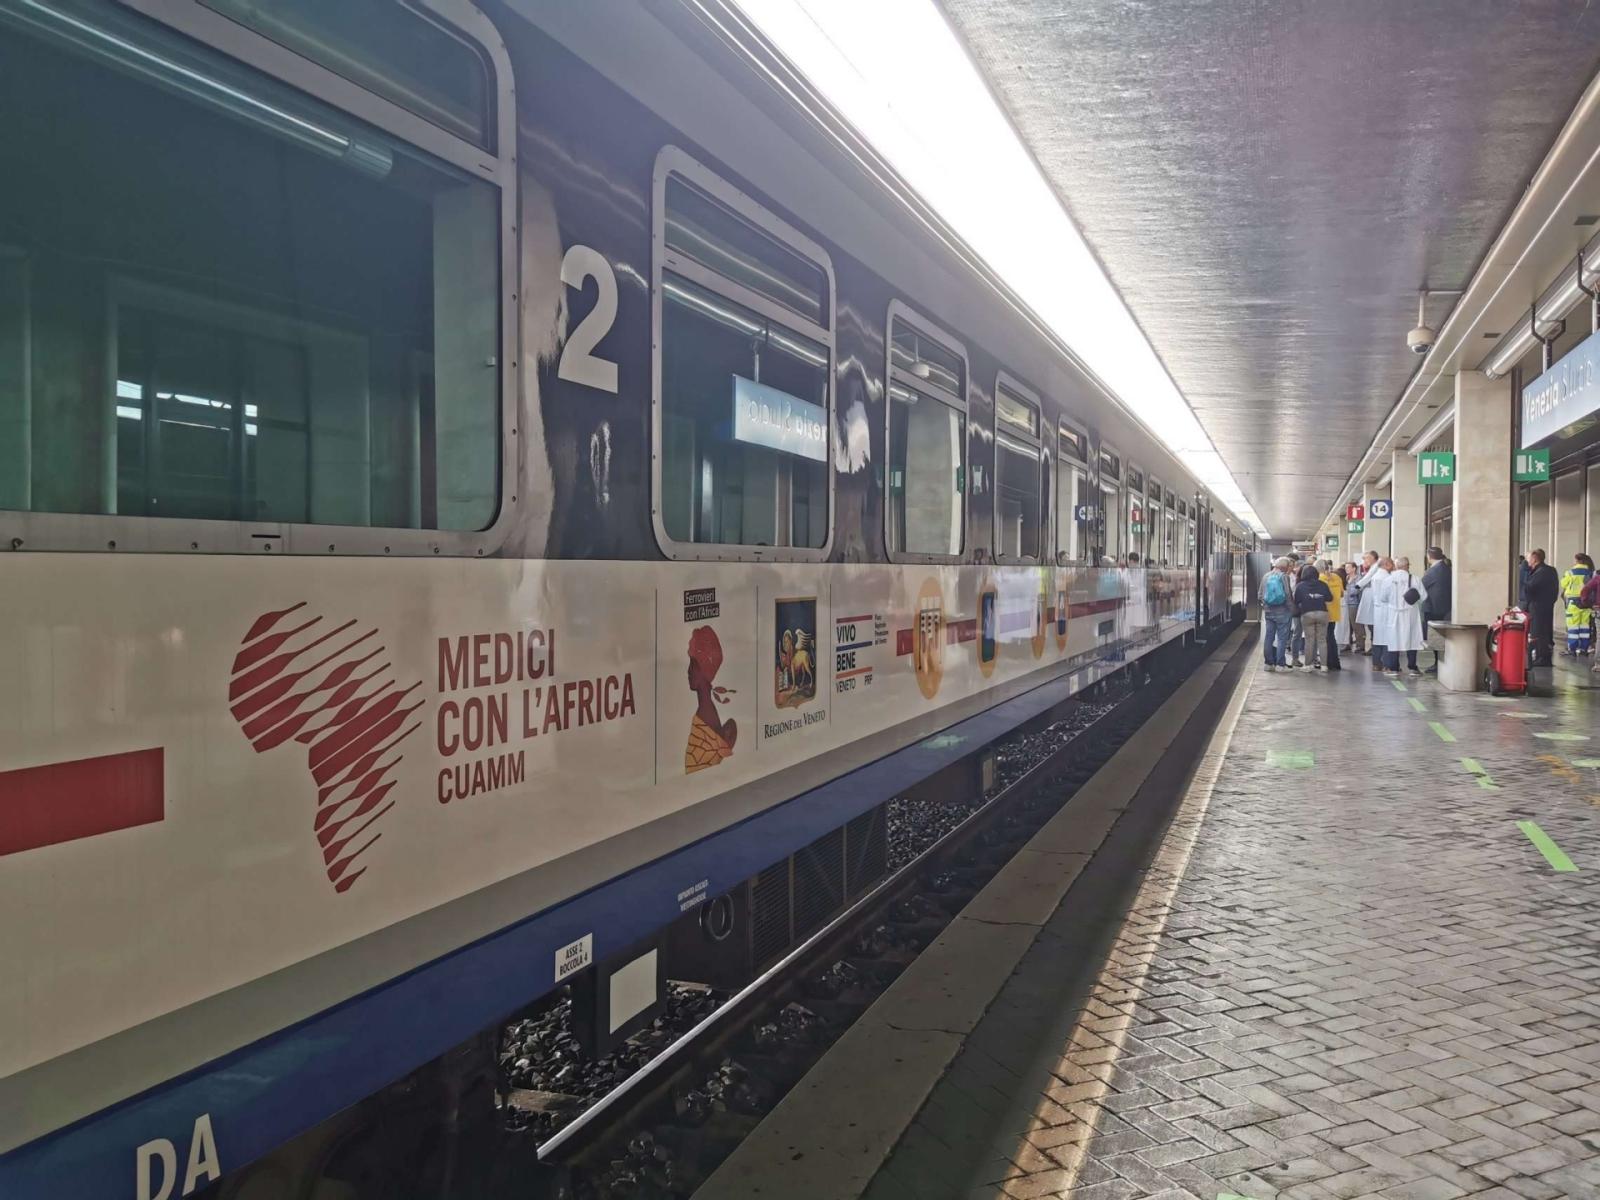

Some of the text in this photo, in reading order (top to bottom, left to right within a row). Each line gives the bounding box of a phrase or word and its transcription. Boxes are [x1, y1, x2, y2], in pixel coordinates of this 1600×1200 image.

[558, 245, 618, 393] 2
[1525, 376, 1559, 424] Venezia
[1374, 505, 1387, 514] 14
[685, 589, 715, 604] Ferrovieri
[685, 610, 698, 621] con
[836, 624, 856, 643] VIVO
[438, 629, 555, 692] MEDICI
[836, 651, 856, 672] BENE
[836, 678, 856, 693] VENETO
[437, 673, 636, 757] CON L'AFRICA
[764, 720, 794, 739] REGIONE
[803, 710, 826, 726] VENETO
[438, 750, 525, 805] CUAMM
[565, 945, 578, 960] ASSE
[559, 954, 583, 976] BOCCOLA
[137, 1113, 221, 1200] DA
